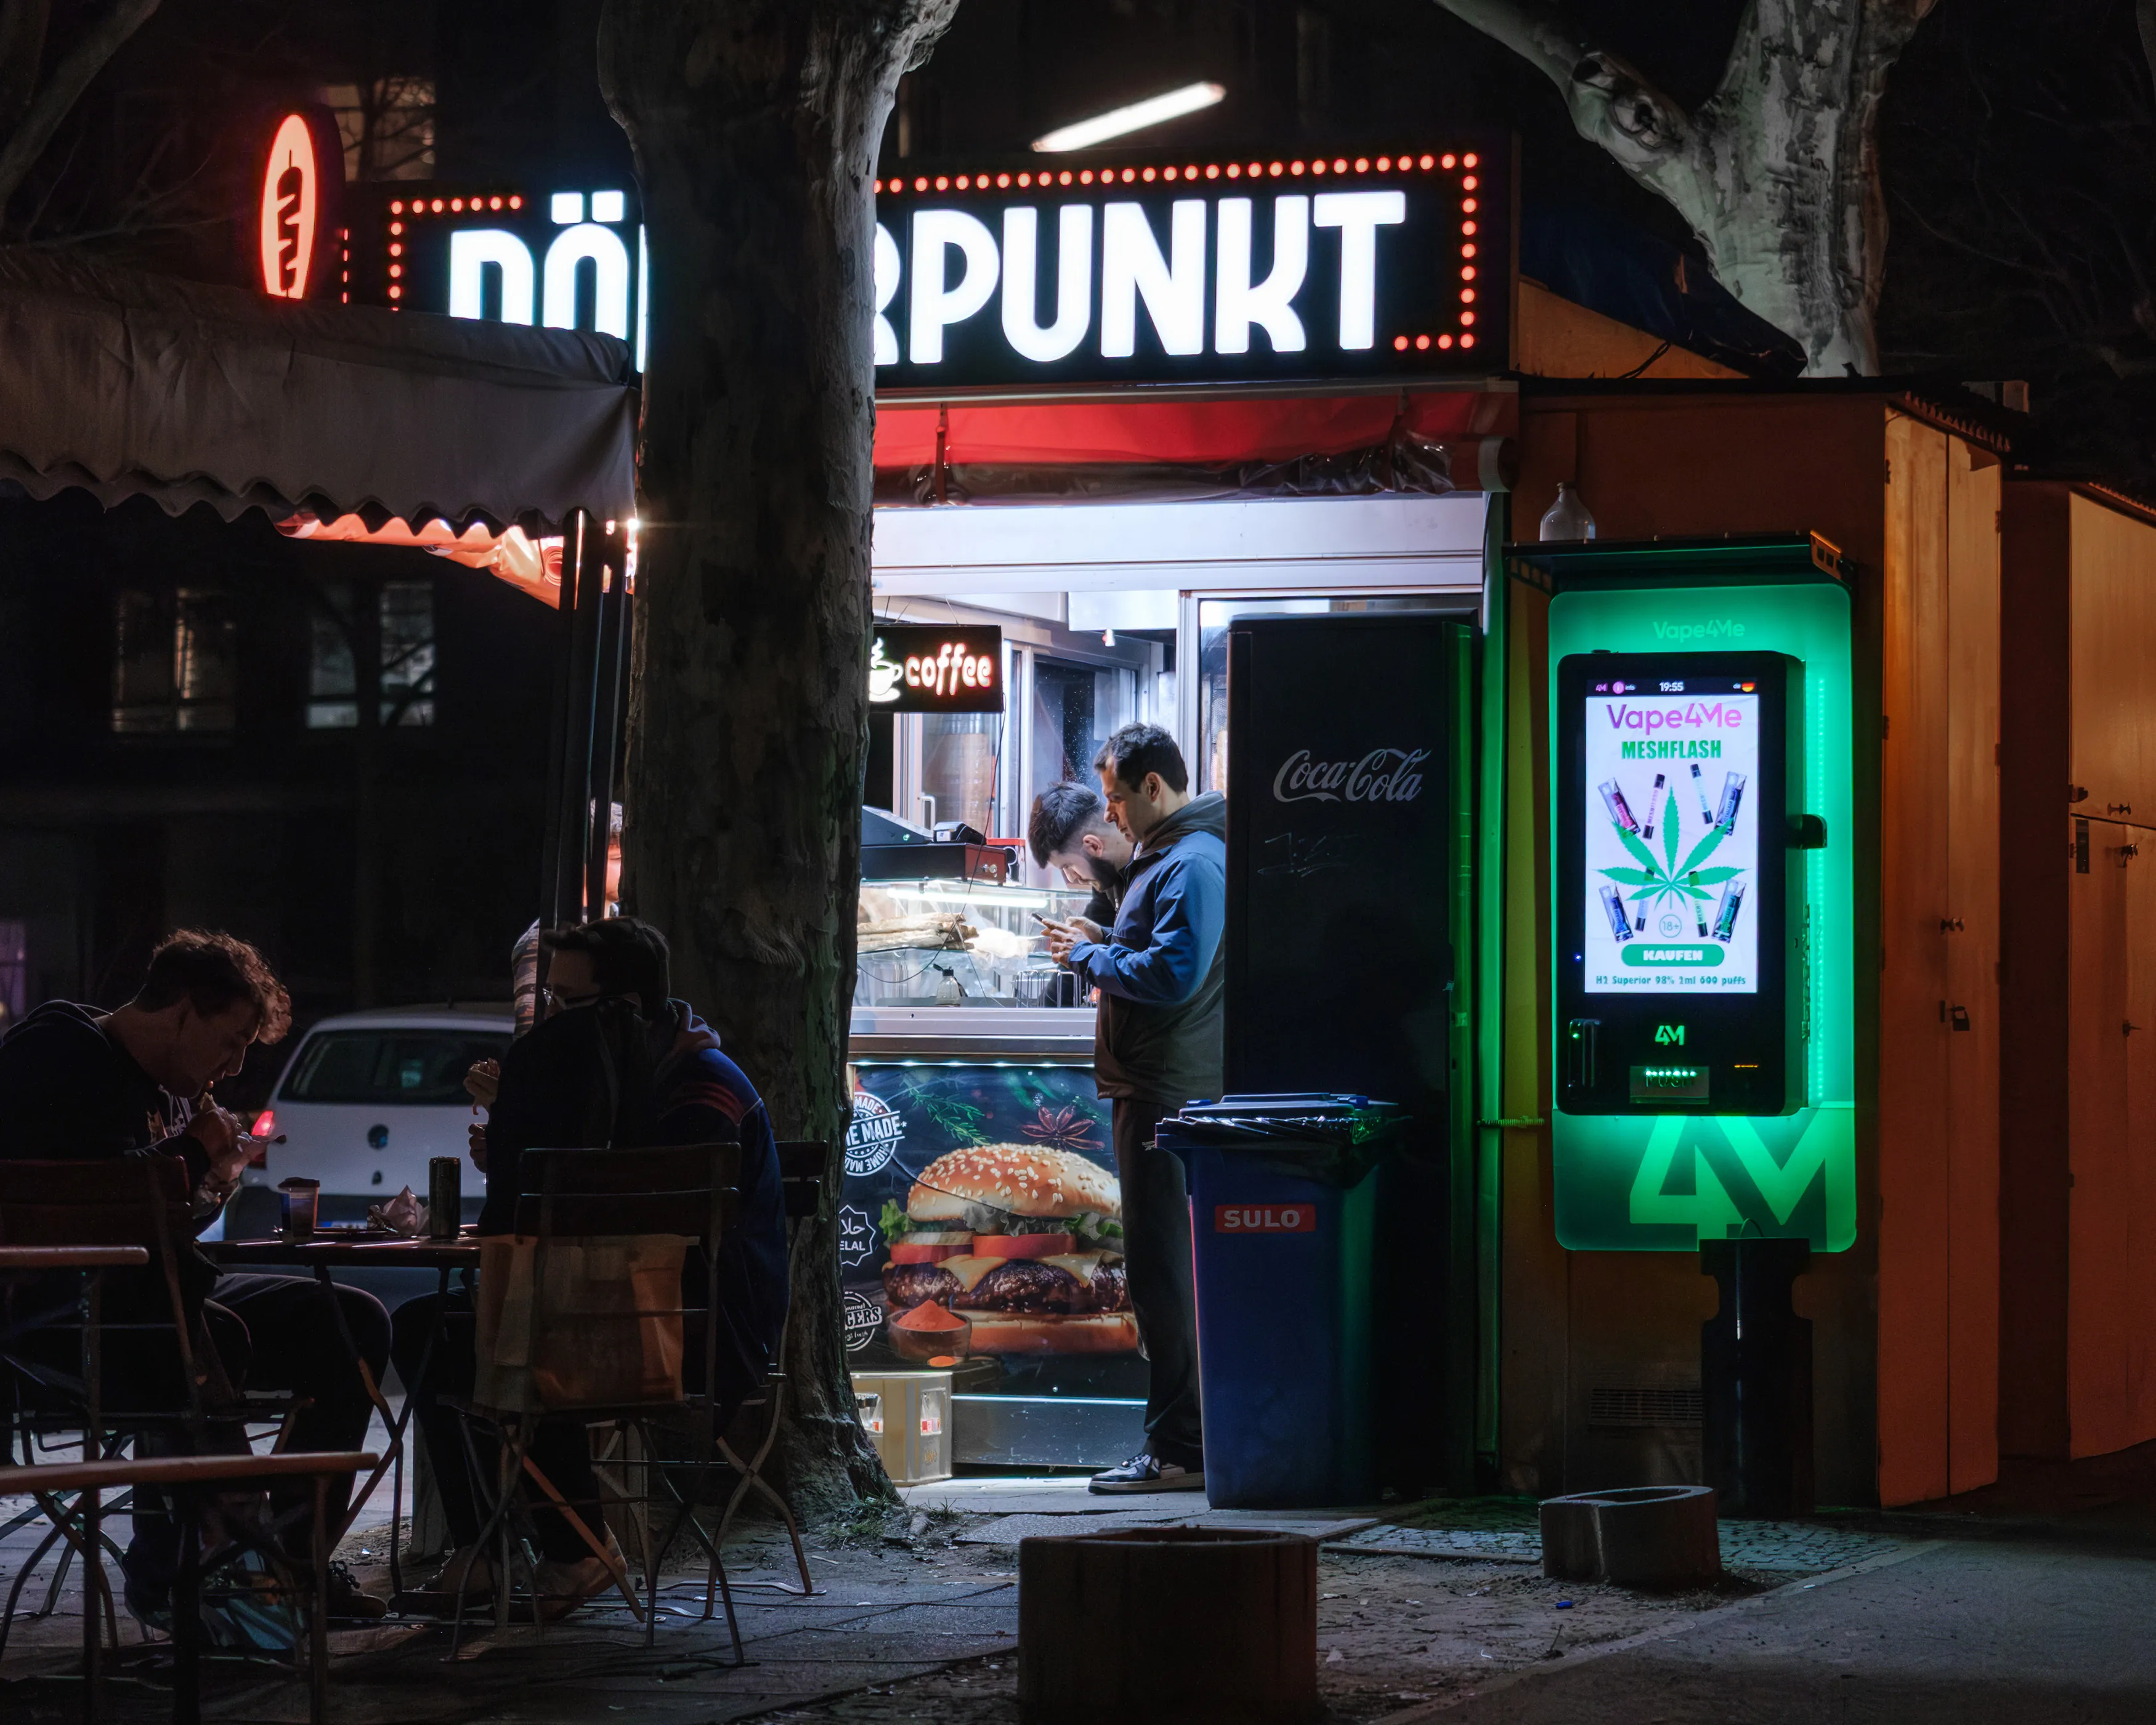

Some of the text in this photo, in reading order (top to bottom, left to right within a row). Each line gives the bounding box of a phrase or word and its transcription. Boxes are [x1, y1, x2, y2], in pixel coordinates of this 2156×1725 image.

[1652, 618, 1746, 644] Vape4Me
[904, 642, 994, 697] coffee
[1659, 680, 1685, 692] 19:55
[1605, 702, 1743, 736] Vape4Me
[1621, 740, 1722, 760] MESHFLASH
[1272, 747, 1433, 803] Coca-Cola
[1663, 920, 1679, 932] 18+
[1642, 949, 1704, 962] KAUFEN
[1611, 975, 1651, 986] Superior
[1721, 975, 1746, 987] puffs
[1655, 1025, 1685, 1046] 4M
[861, 1115, 902, 1143] MADE
[864, 1145, 888, 1171] HOME
[1223, 1209, 1300, 1228] SULO
[840, 1240, 866, 1251] ELAL
